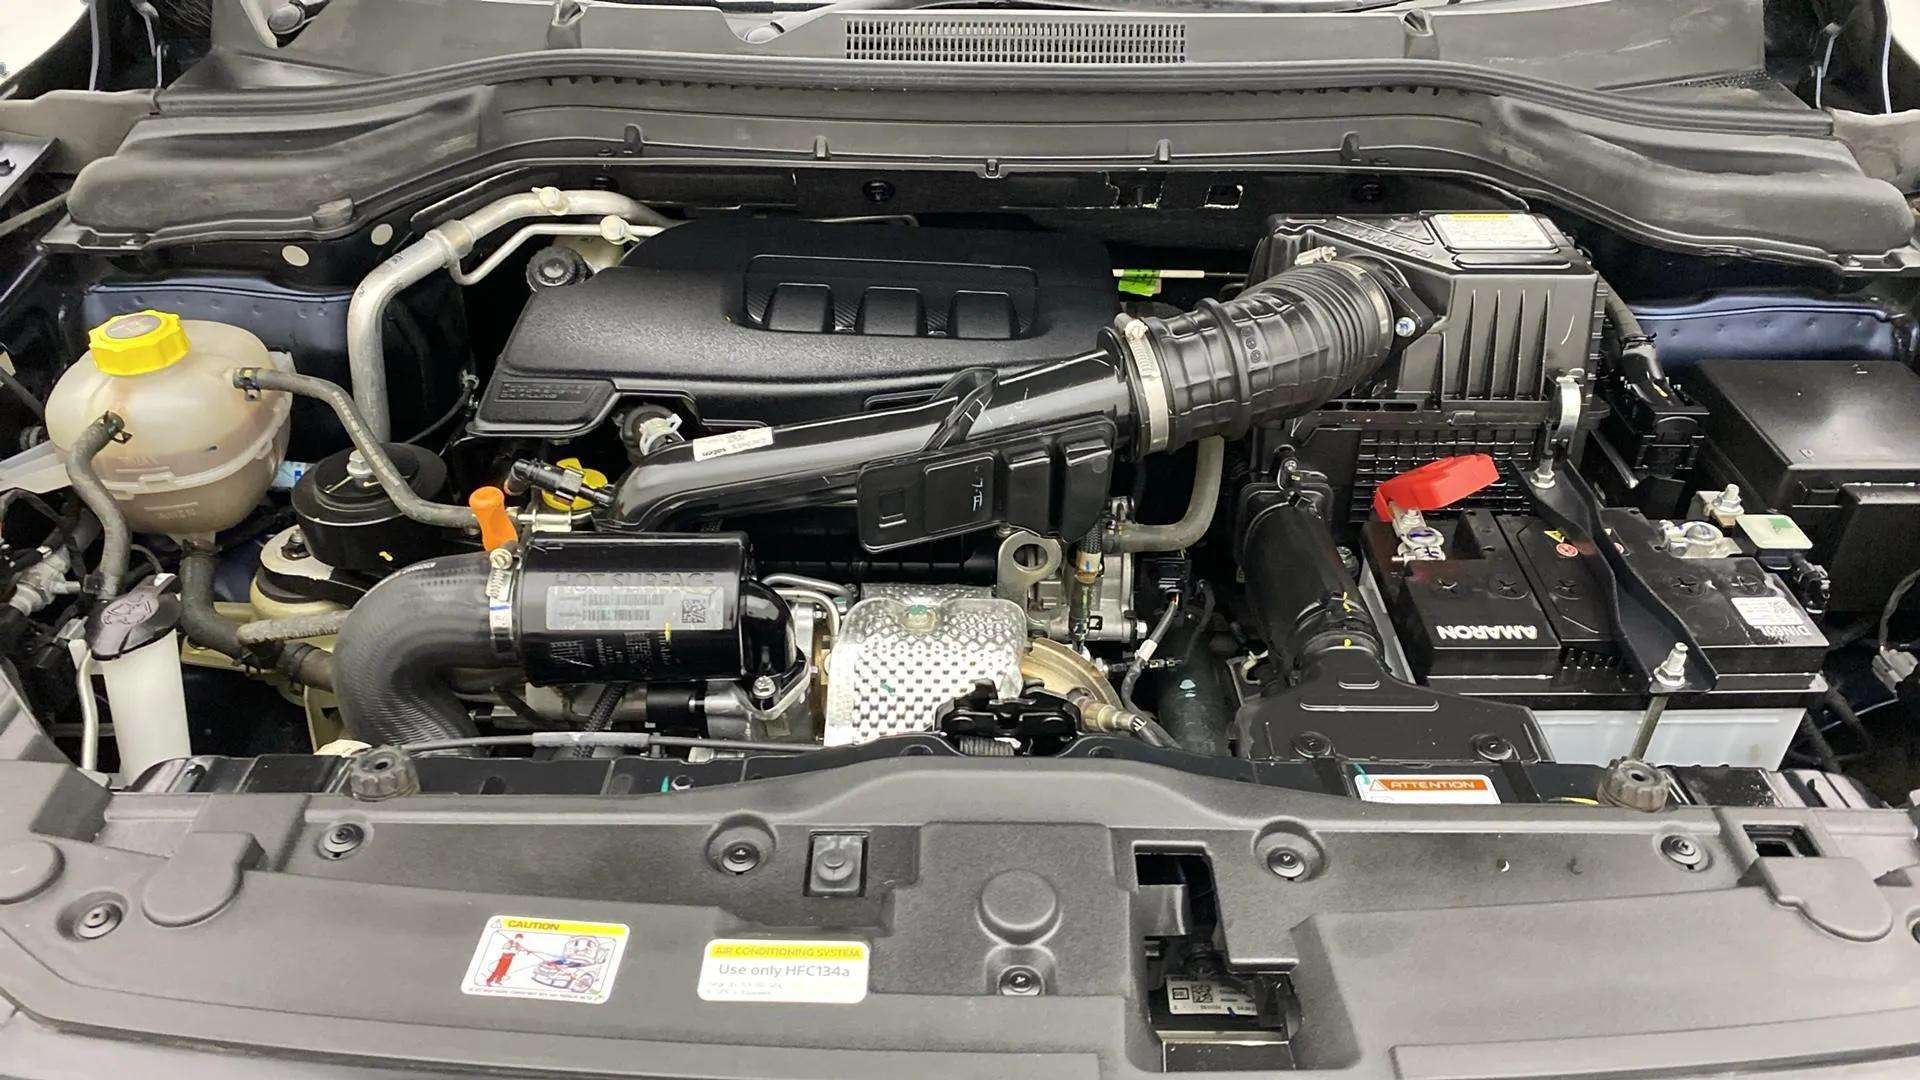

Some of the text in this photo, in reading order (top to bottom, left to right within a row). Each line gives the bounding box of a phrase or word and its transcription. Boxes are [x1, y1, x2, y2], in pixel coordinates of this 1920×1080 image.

[1436, 625, 1538, 640] AMARON
[1390, 781, 1476, 789] ATTENTION
[507, 919, 561, 931] CAUTION
[714, 946, 861, 958] AIR CONDITIONING SYSTEM
[718, 963, 850, 978] Use only HFC134a
